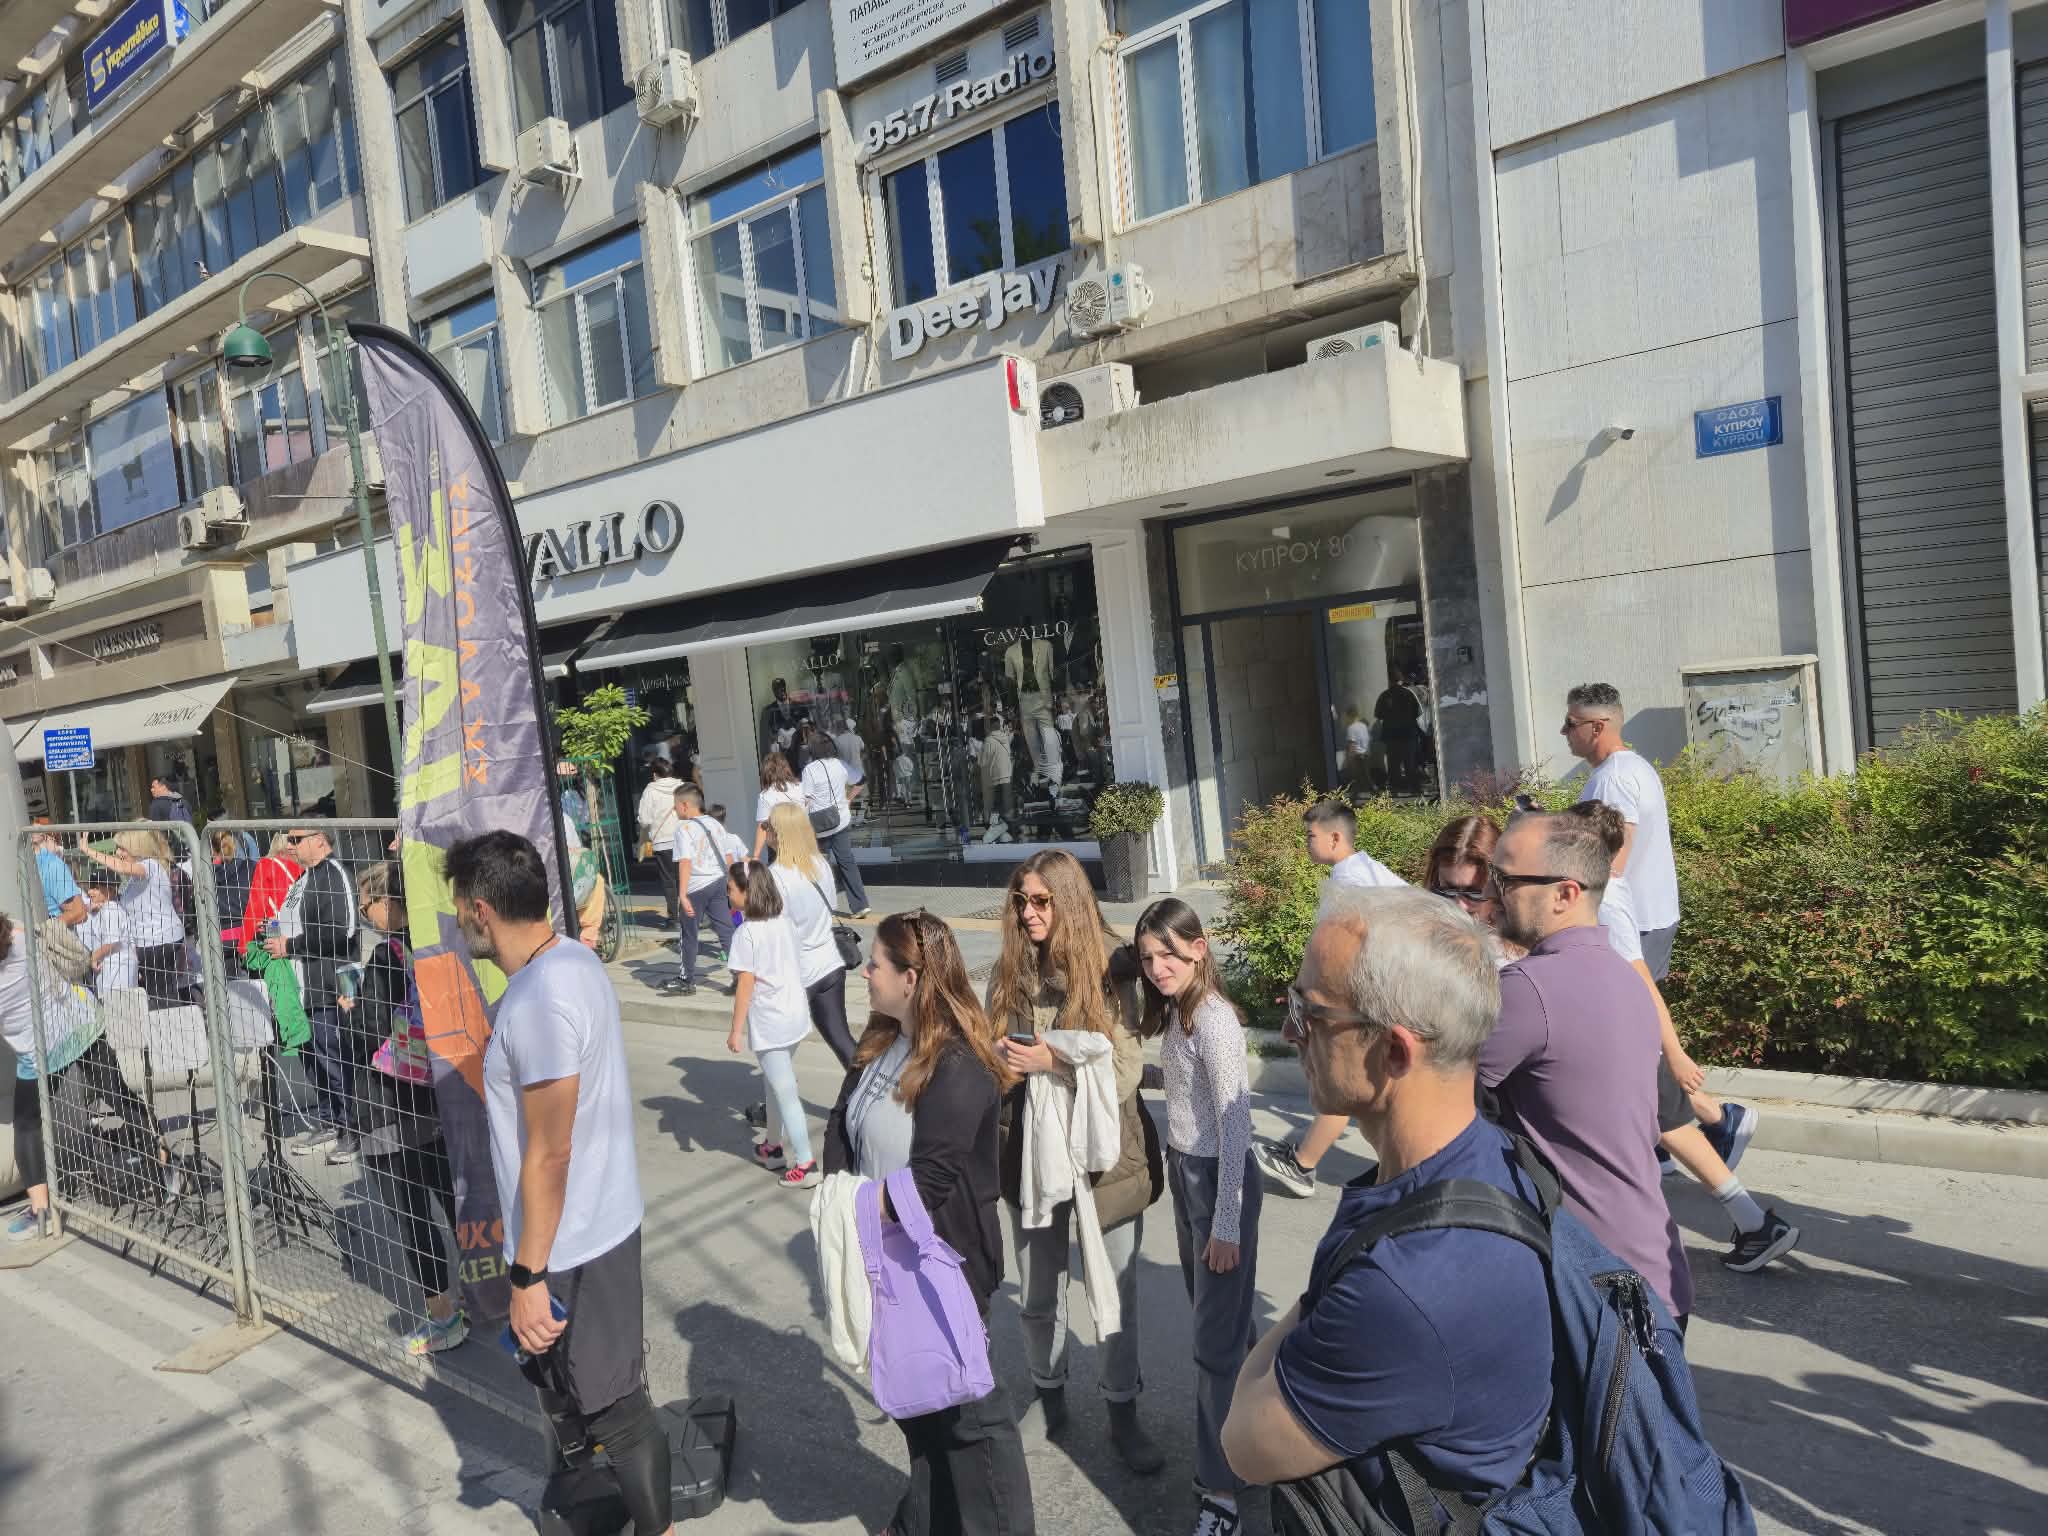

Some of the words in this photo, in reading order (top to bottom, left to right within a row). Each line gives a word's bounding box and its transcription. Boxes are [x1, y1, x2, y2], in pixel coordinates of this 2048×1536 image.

[864, 94, 939, 153] 95.7
[946, 51, 1057, 118] Radio
[1714, 415, 1764, 435] ΚΥΠΡΟΥ
[1235, 536, 1321, 573] ΚΥΠΡΟΥ
[983, 620, 1069, 647] CAVALLO
